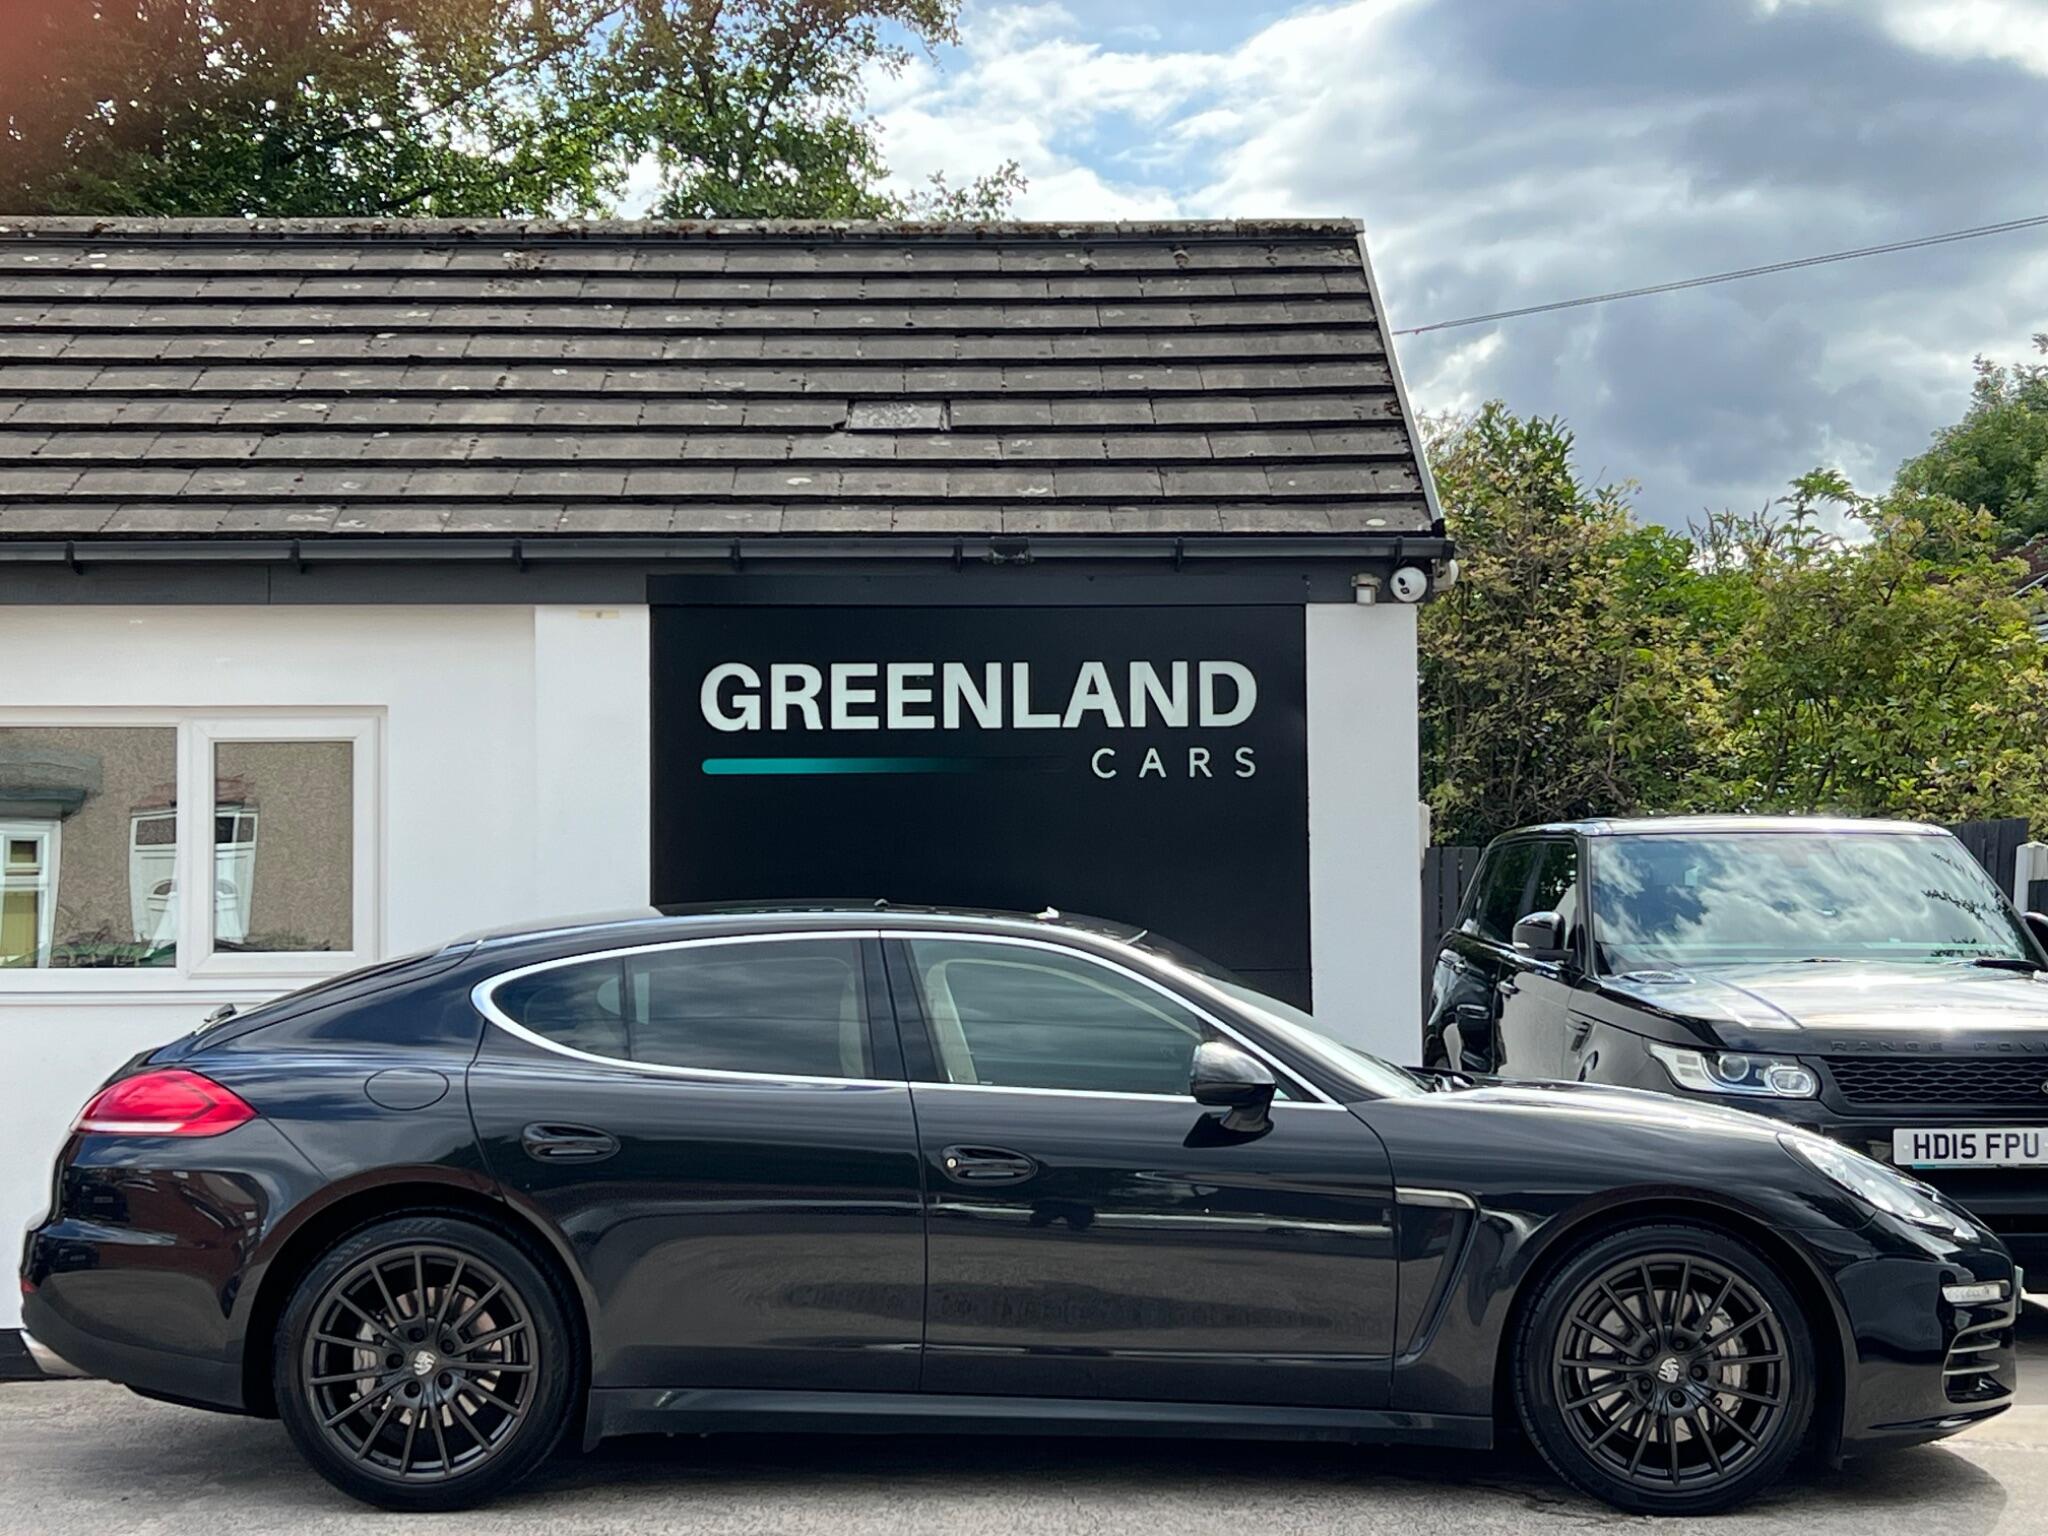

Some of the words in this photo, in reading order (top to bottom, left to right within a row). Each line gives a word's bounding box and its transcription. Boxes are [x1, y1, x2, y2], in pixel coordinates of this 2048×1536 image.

[700, 660, 1257, 732] GREENLAND
[1091, 747, 1257, 779] CARS
[1831, 1040, 1943, 1052] RANGE
[1913, 1133, 1977, 1160] HD15
[1985, 1132, 2039, 1160] FPU
